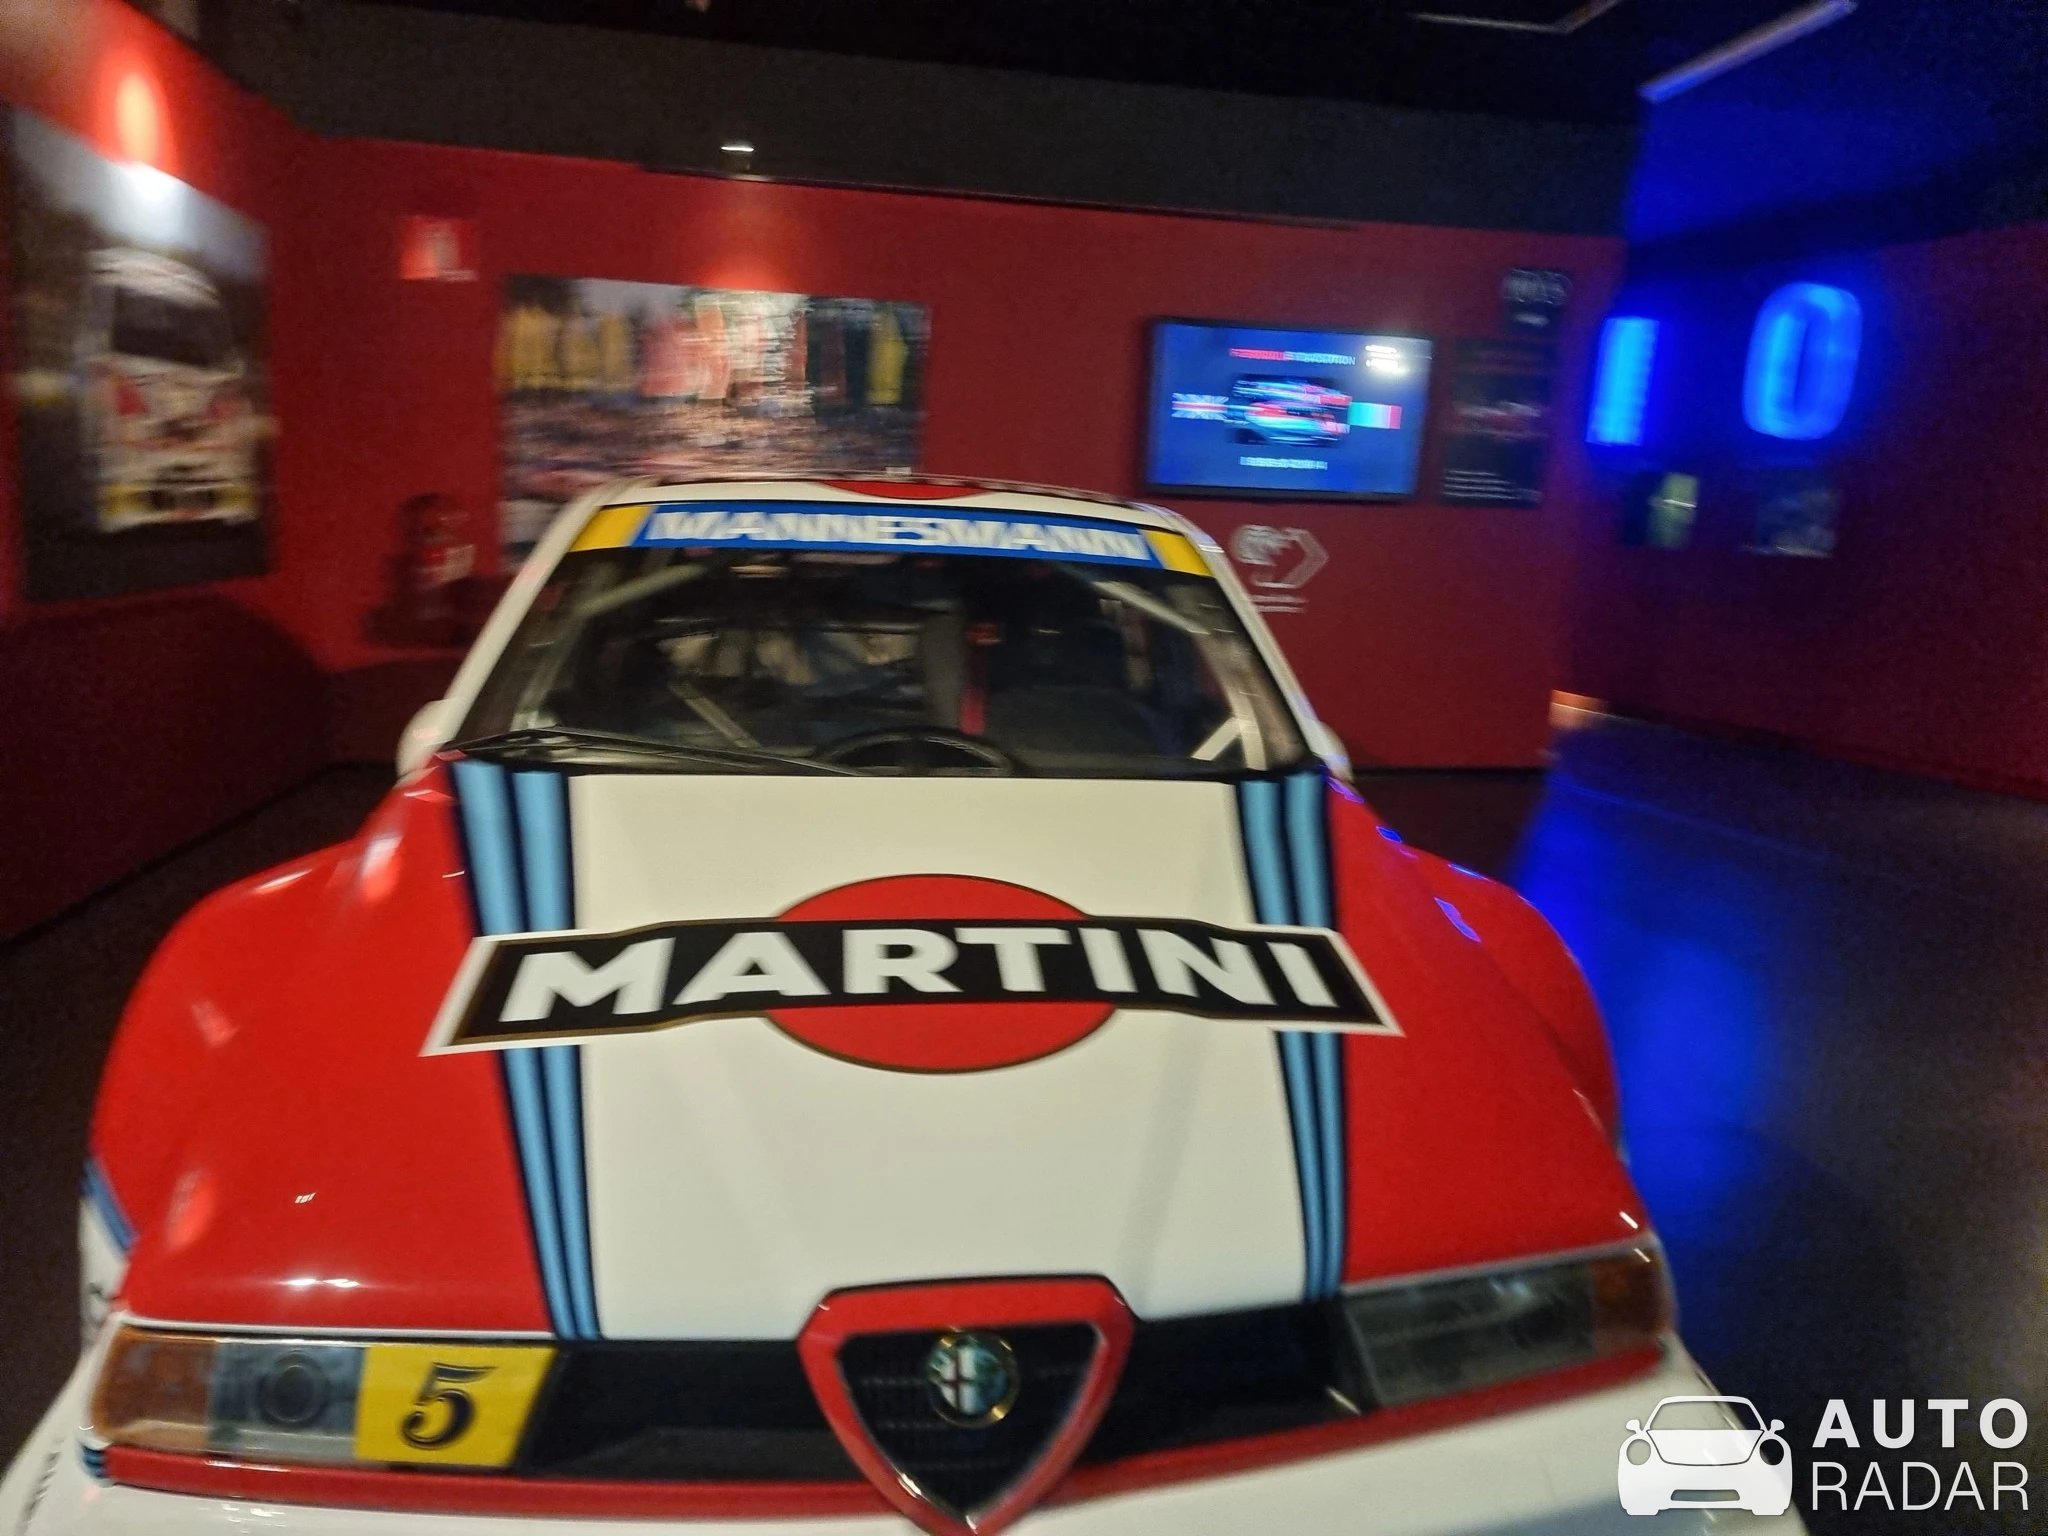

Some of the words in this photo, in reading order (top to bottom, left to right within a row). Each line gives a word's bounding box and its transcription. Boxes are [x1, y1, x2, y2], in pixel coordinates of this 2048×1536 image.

[644, 510, 1152, 561] MANNESMANN
[499, 928, 1339, 1022] MARTINI
[401, 1361, 496, 1450] 5
